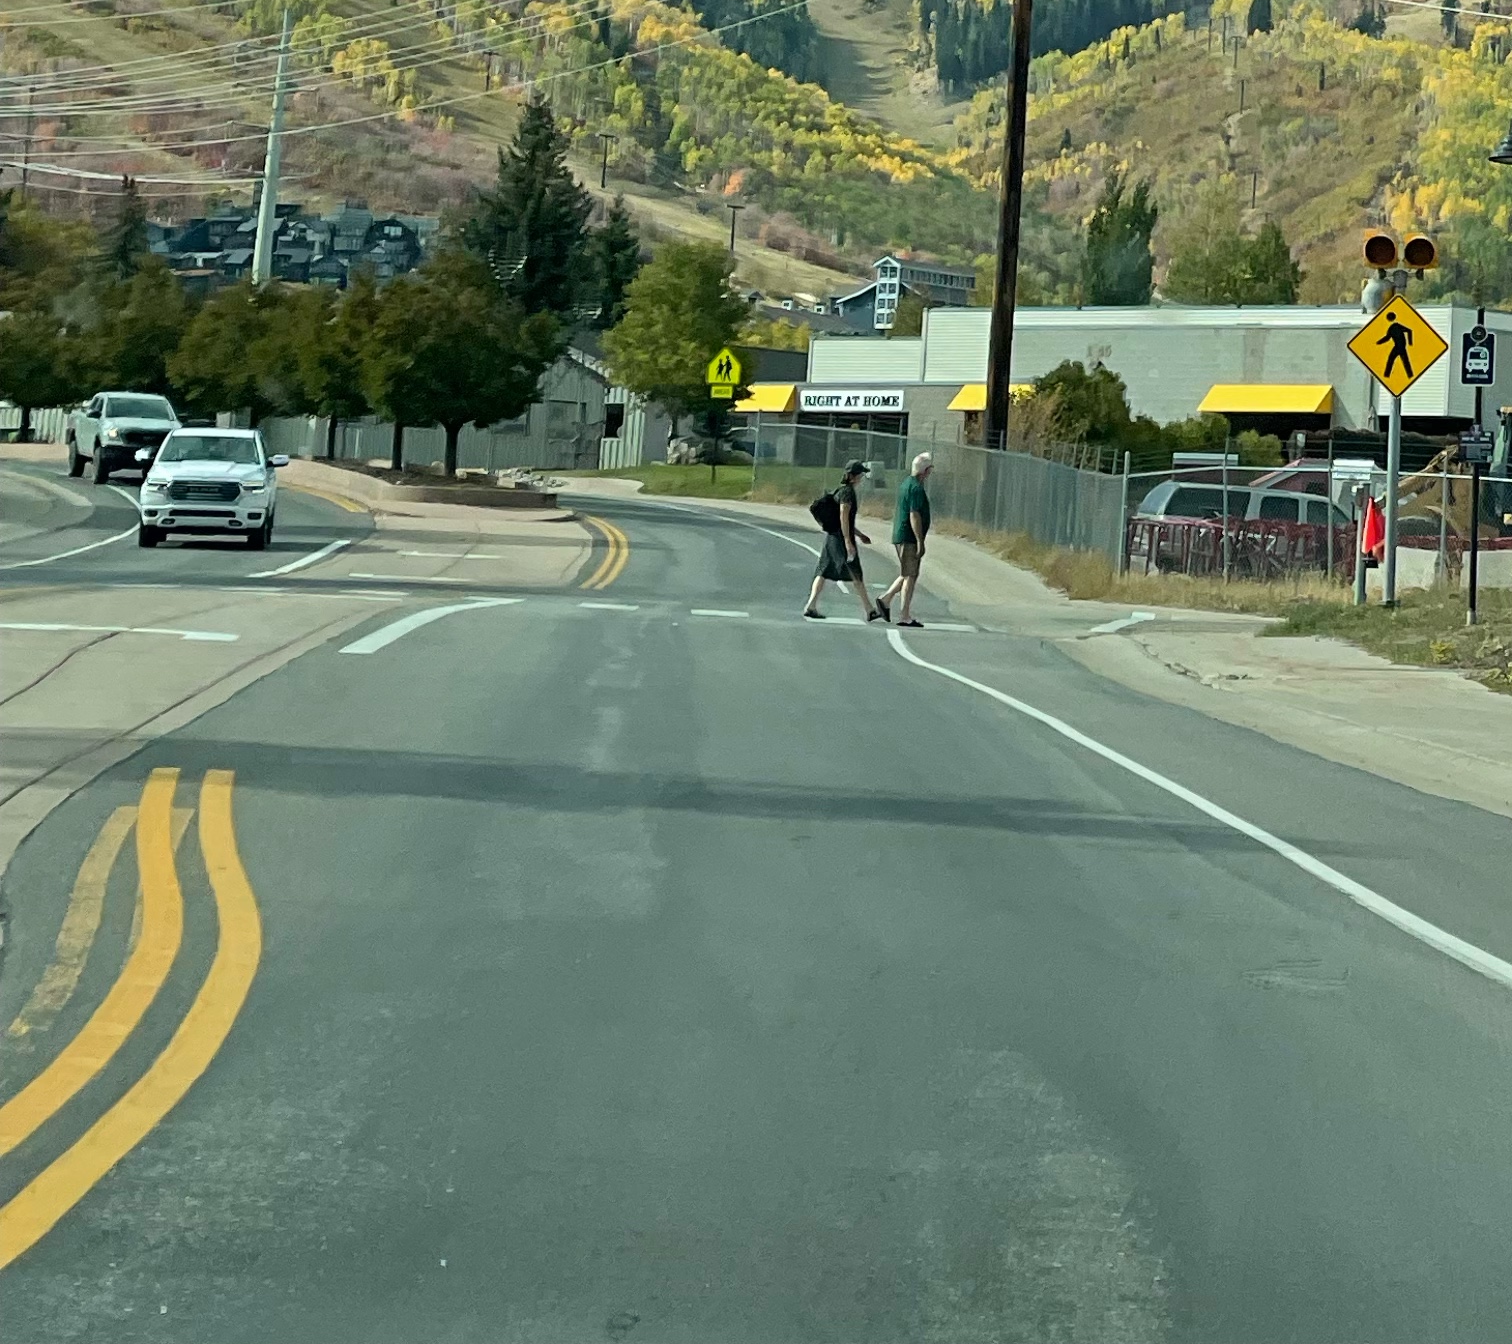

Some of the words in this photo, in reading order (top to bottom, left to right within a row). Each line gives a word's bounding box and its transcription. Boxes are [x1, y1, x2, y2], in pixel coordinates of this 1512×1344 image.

[804, 396, 842, 407] RIGHT
[844, 396, 860, 407] AT
[863, 396, 899, 407] HOME
